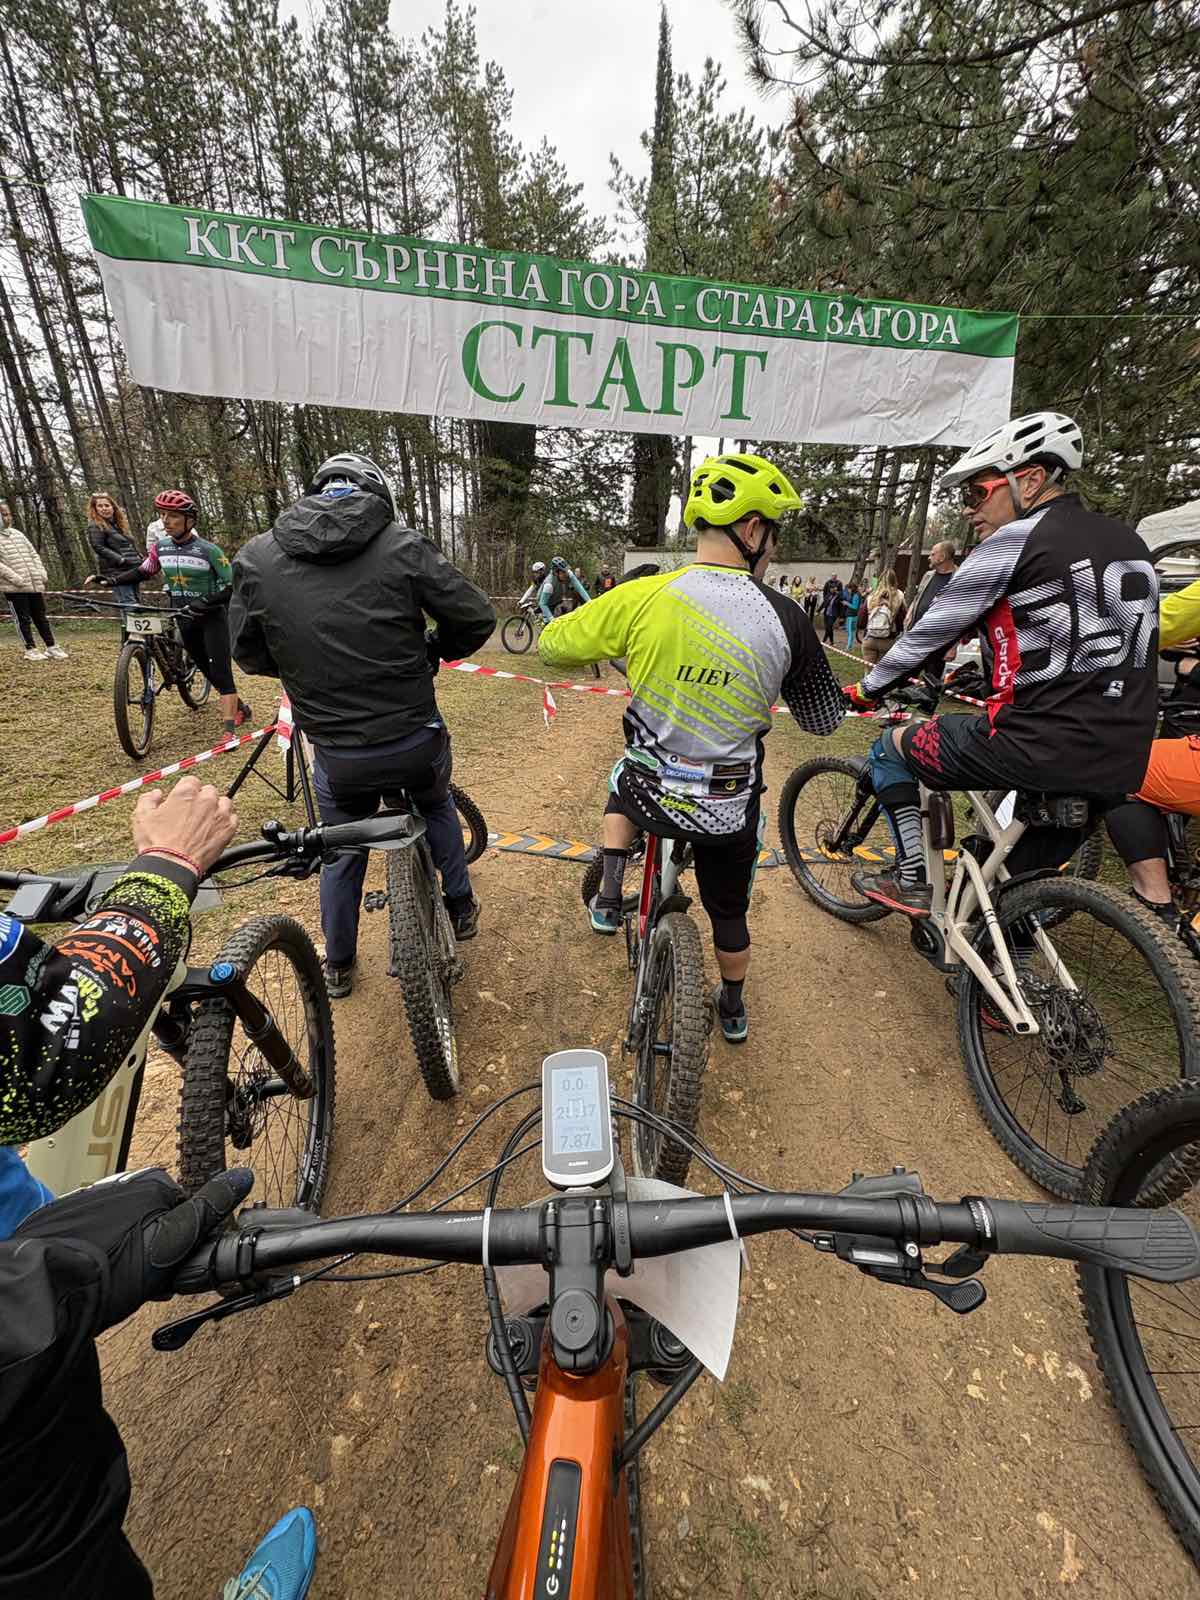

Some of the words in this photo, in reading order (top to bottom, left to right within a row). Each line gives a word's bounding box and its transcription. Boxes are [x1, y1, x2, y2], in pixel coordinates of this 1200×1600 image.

[183, 216, 295, 271] ККТ
[309, 236, 549, 302] СЪРНЕНА
[557, 268, 666, 318] ГОРА
[695, 288, 819, 335] СТАРА
[825, 302, 961, 345] ЗАГОРА
[461, 320, 768, 421] СТАРТ
[133, 619, 153, 632] 62
[676, 664, 739, 688] ILIEV
